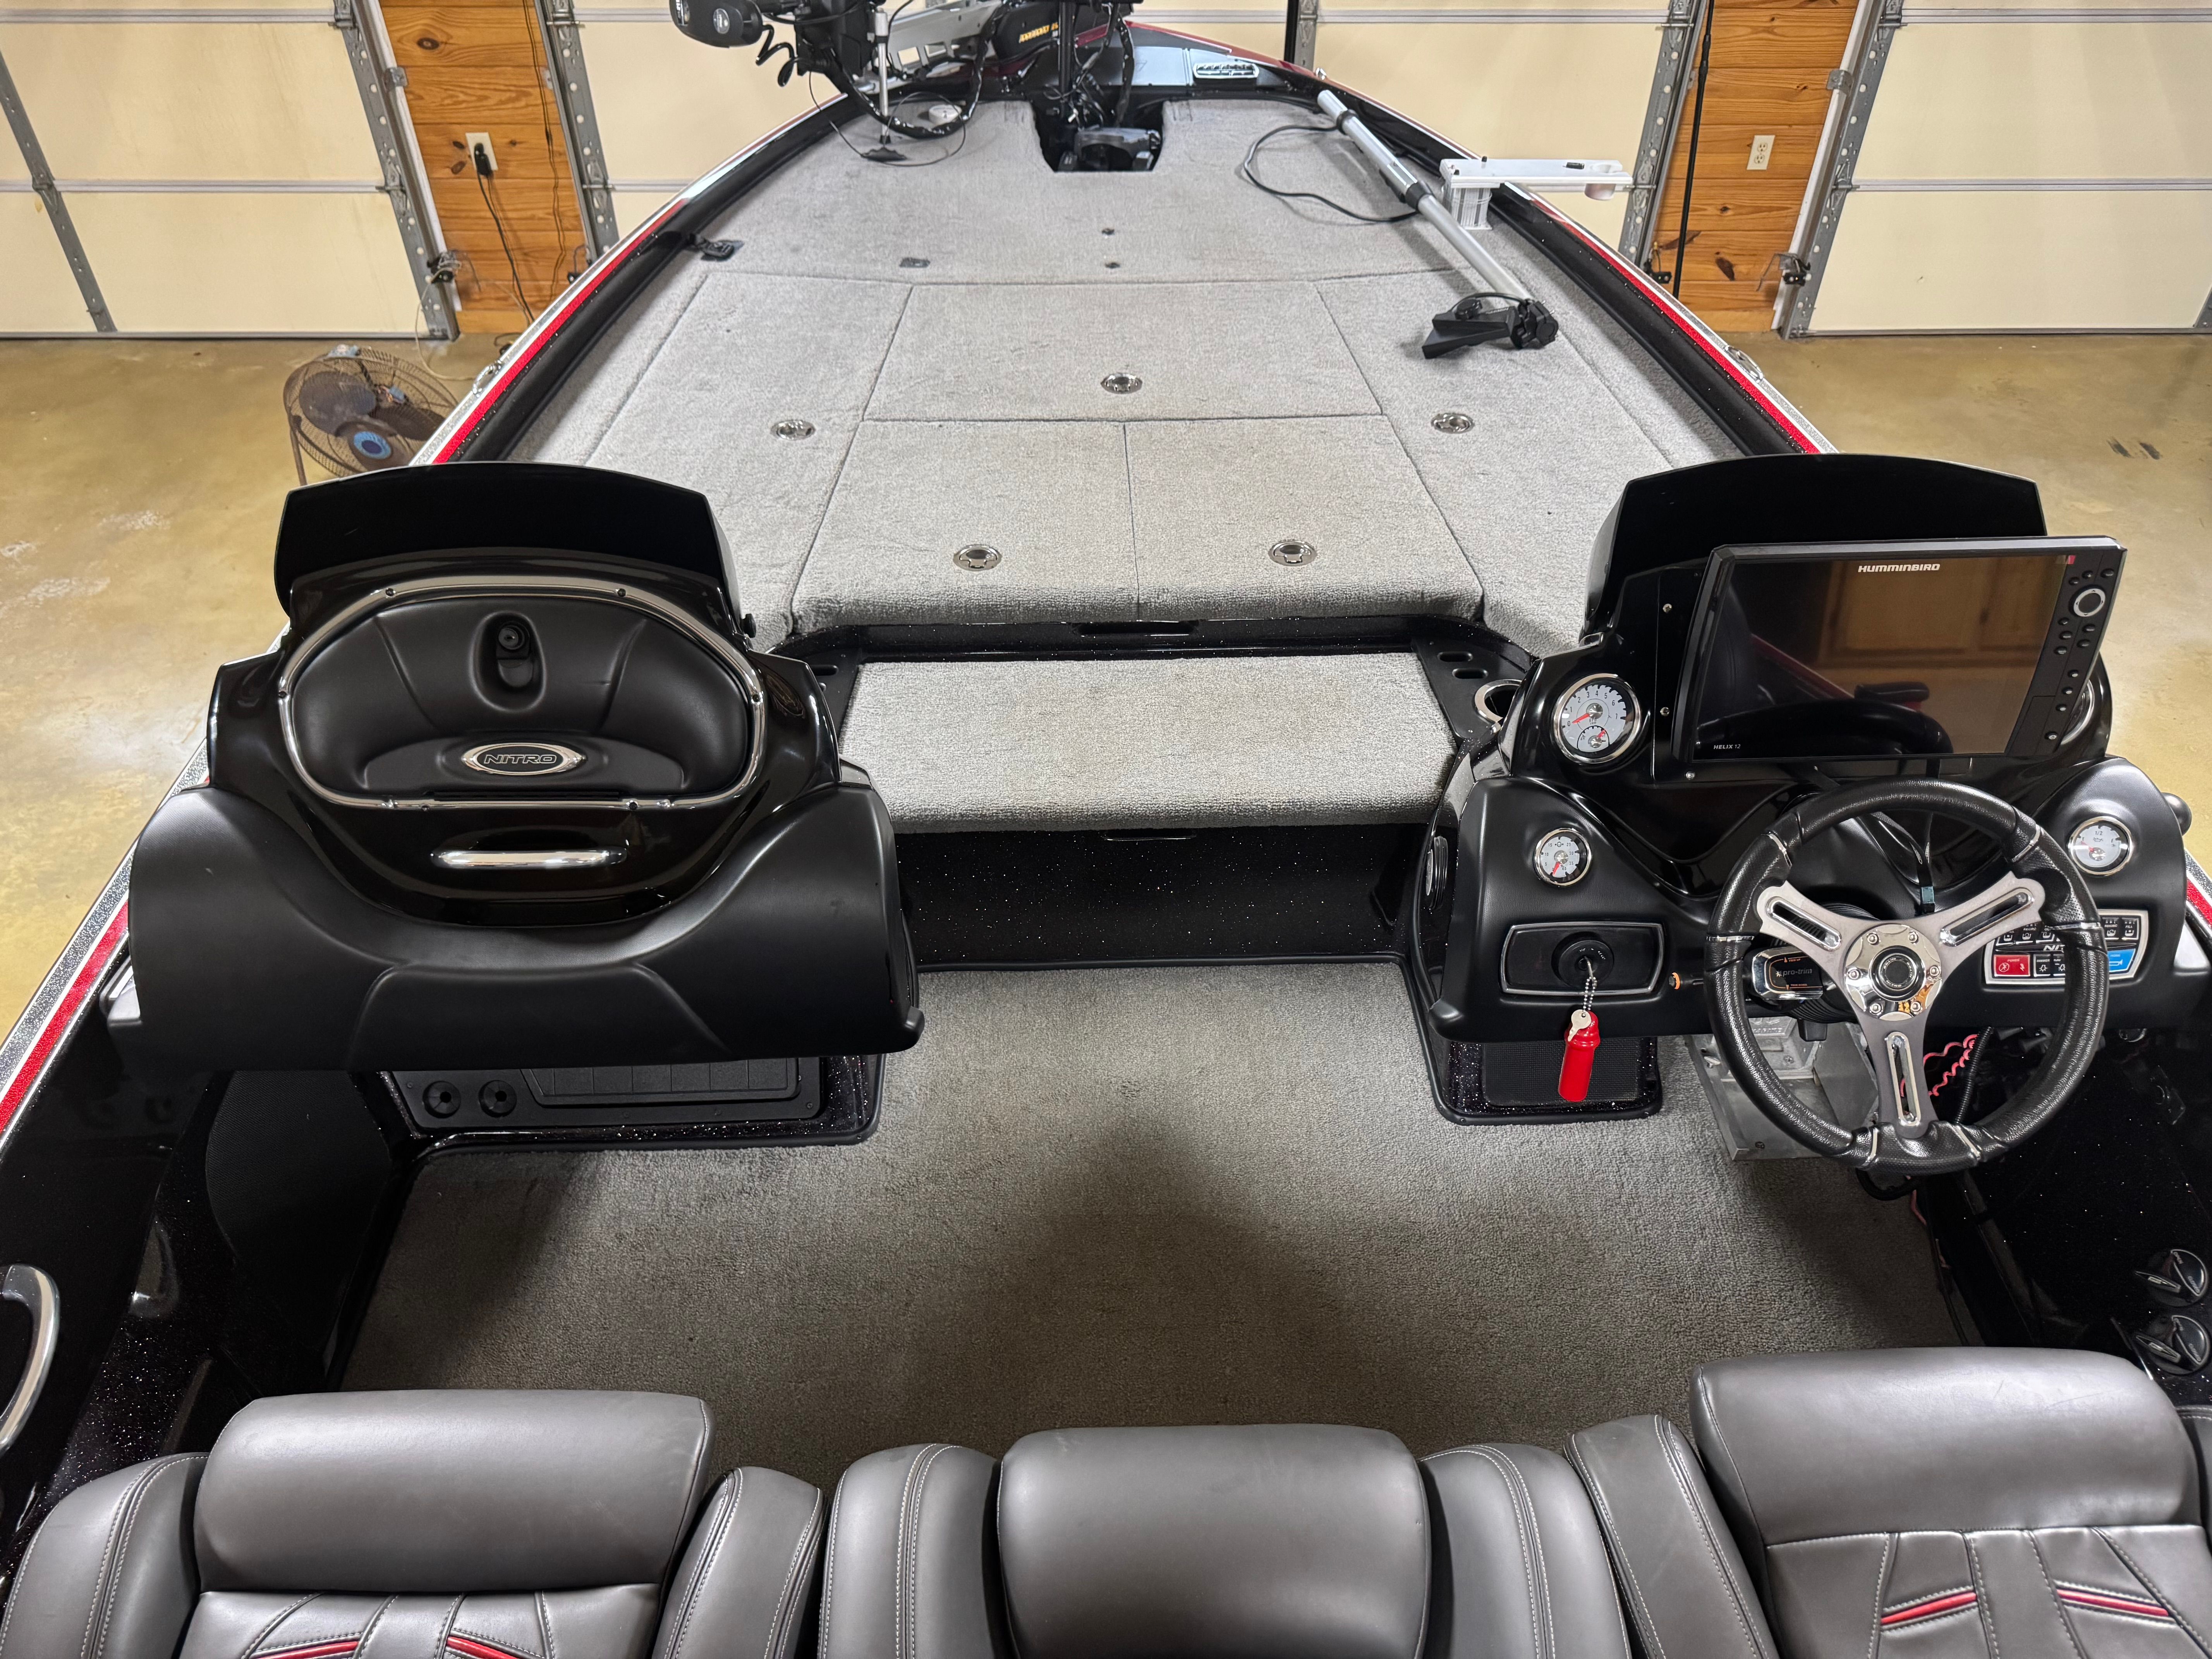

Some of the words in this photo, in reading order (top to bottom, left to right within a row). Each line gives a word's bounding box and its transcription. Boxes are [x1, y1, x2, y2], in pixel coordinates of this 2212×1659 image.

[1858, 564, 1940, 572] HUMMINBIRD
[484, 754, 557, 764] NITRO
[1783, 969, 1812, 977] pro-trim
